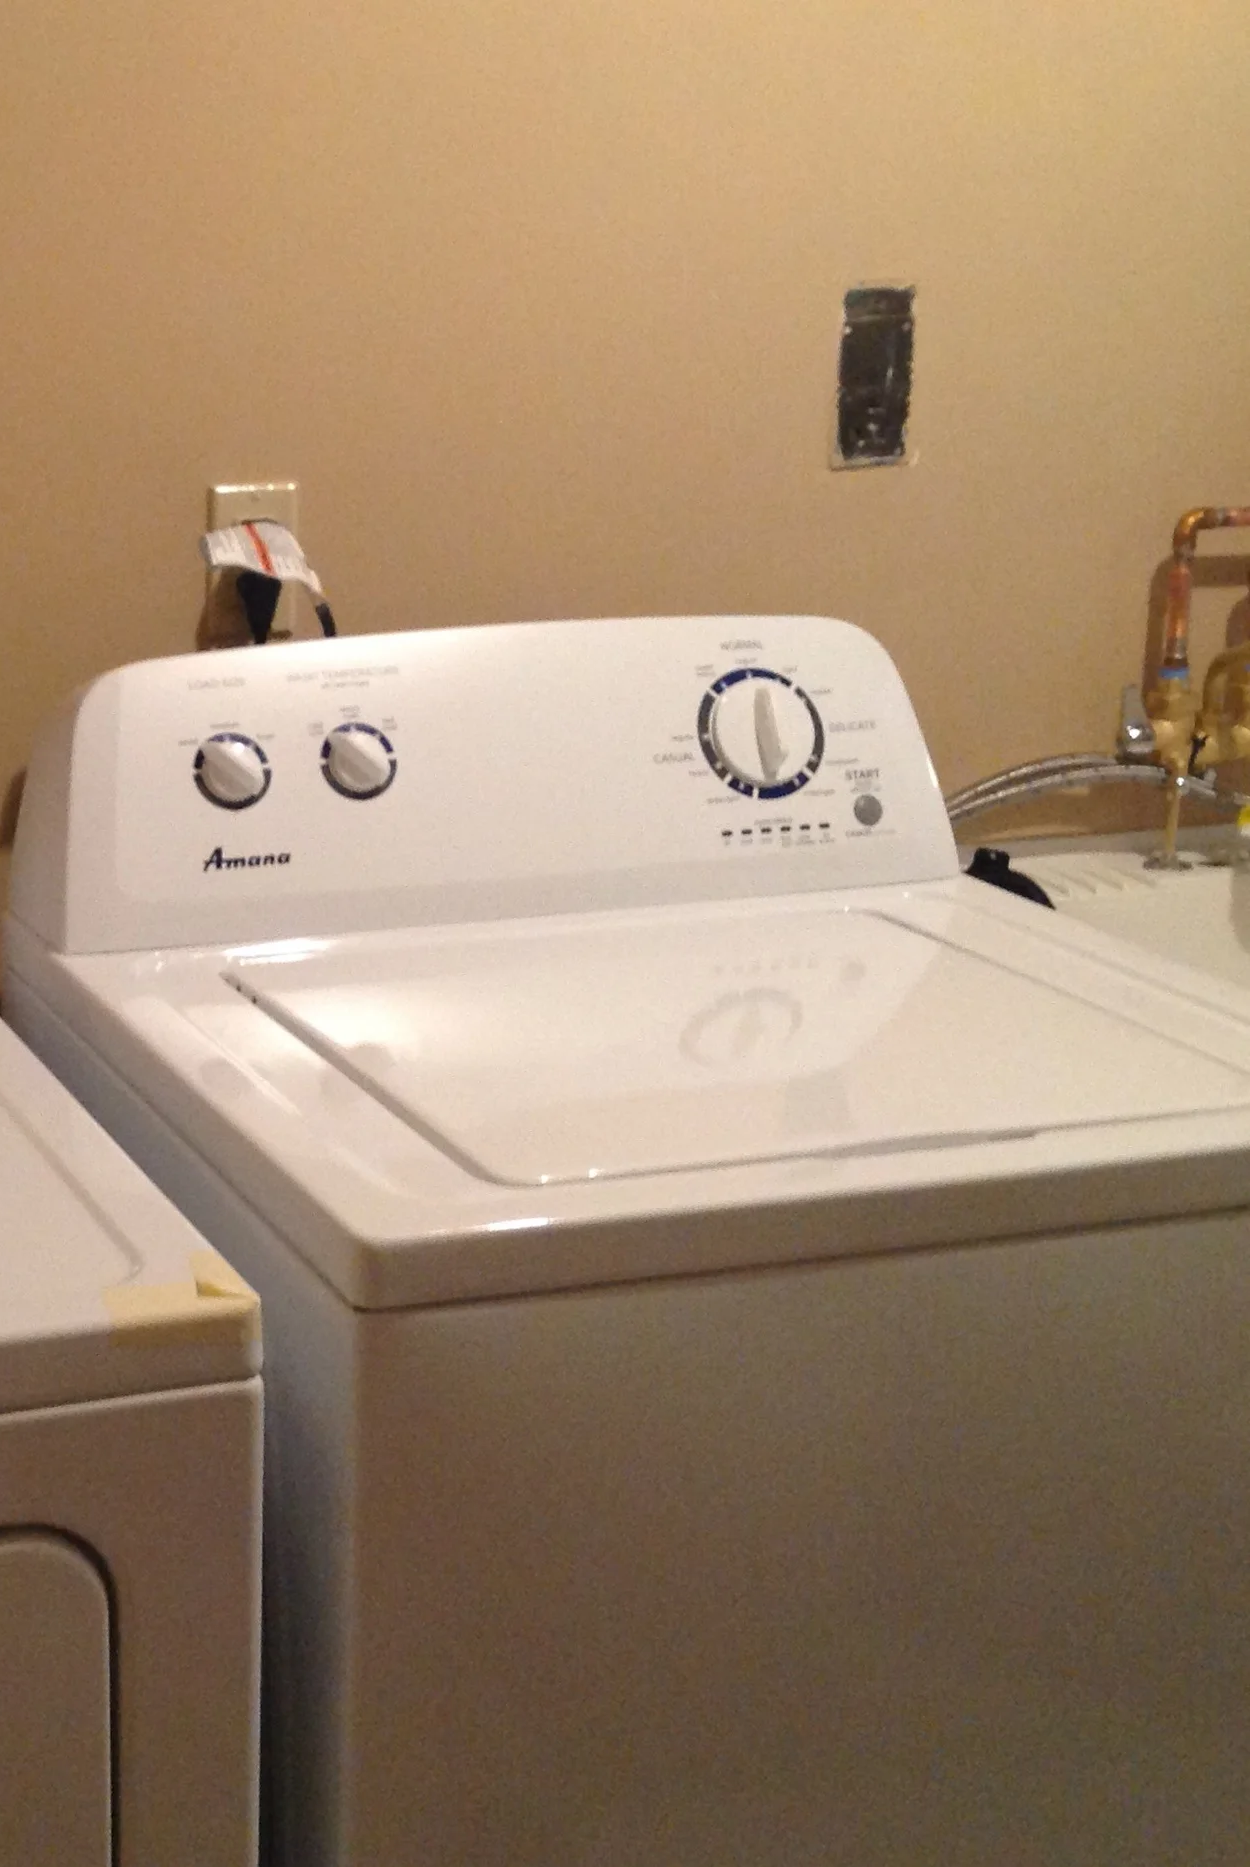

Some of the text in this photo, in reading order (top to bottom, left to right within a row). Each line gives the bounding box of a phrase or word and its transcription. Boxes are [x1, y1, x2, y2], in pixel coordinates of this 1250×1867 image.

[828, 720, 877, 734] DELICATE
[652, 752, 696, 765] CASUAL
[844, 768, 881, 783] START
[203, 845, 292, 873] Amana
